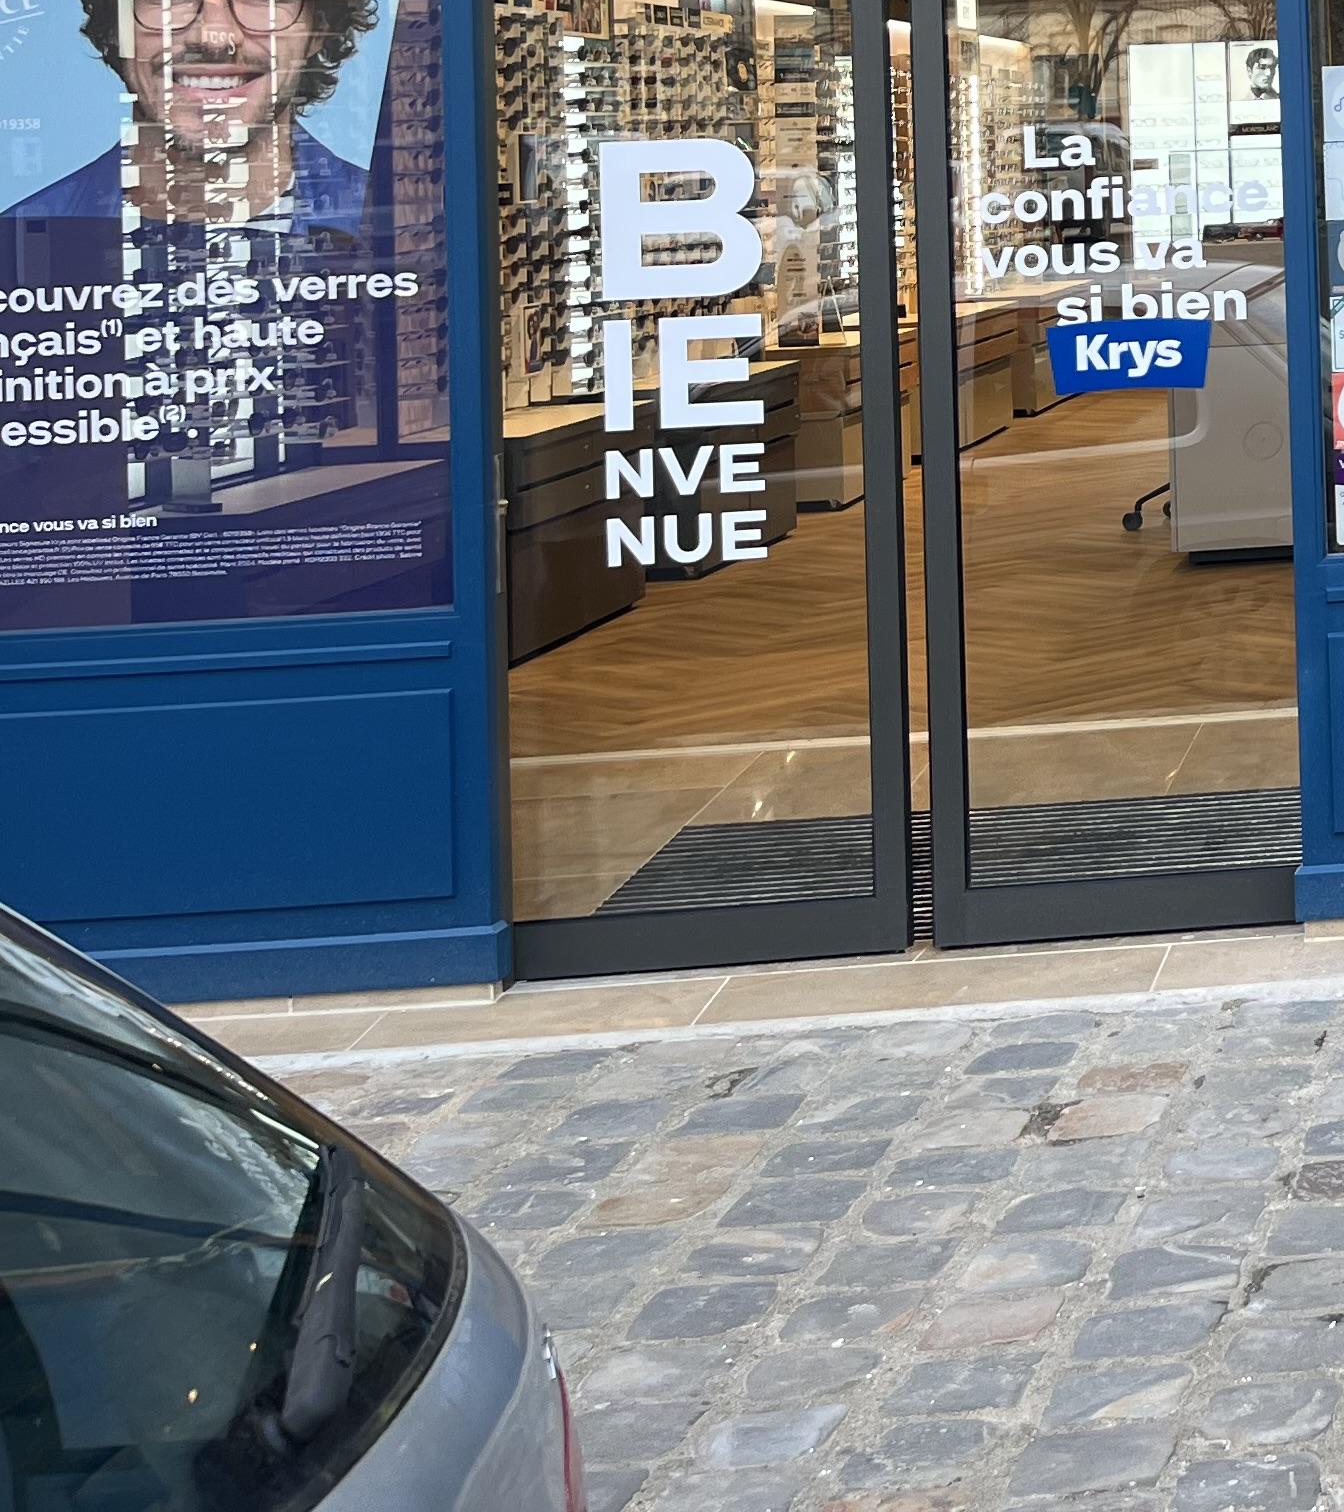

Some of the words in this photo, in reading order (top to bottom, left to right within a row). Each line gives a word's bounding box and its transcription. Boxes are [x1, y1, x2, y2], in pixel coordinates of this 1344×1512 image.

[1023, 126, 1095, 170] La
[979, 176, 1269, 225] confiance
[982, 239, 1120, 279] vous
[1135, 238, 1207, 271] va
[176, 274, 259, 307] des
[274, 270, 419, 301] verres
[1057, 284, 1102, 326] si
[1121, 282, 1247, 321] bien
[136, 321, 180, 353] et
[194, 316, 324, 353] haute
[1075, 334, 1183, 377] Krys
[145, 363, 173, 396] à
[186, 360, 276, 404] prix
[604, 444, 766, 500] NVE
[33, 519, 74, 532] vous
[78, 519, 99, 530] va
[102, 515, 116, 529] si
[120, 514, 158, 529] bien
[606, 510, 768, 568] NUE
